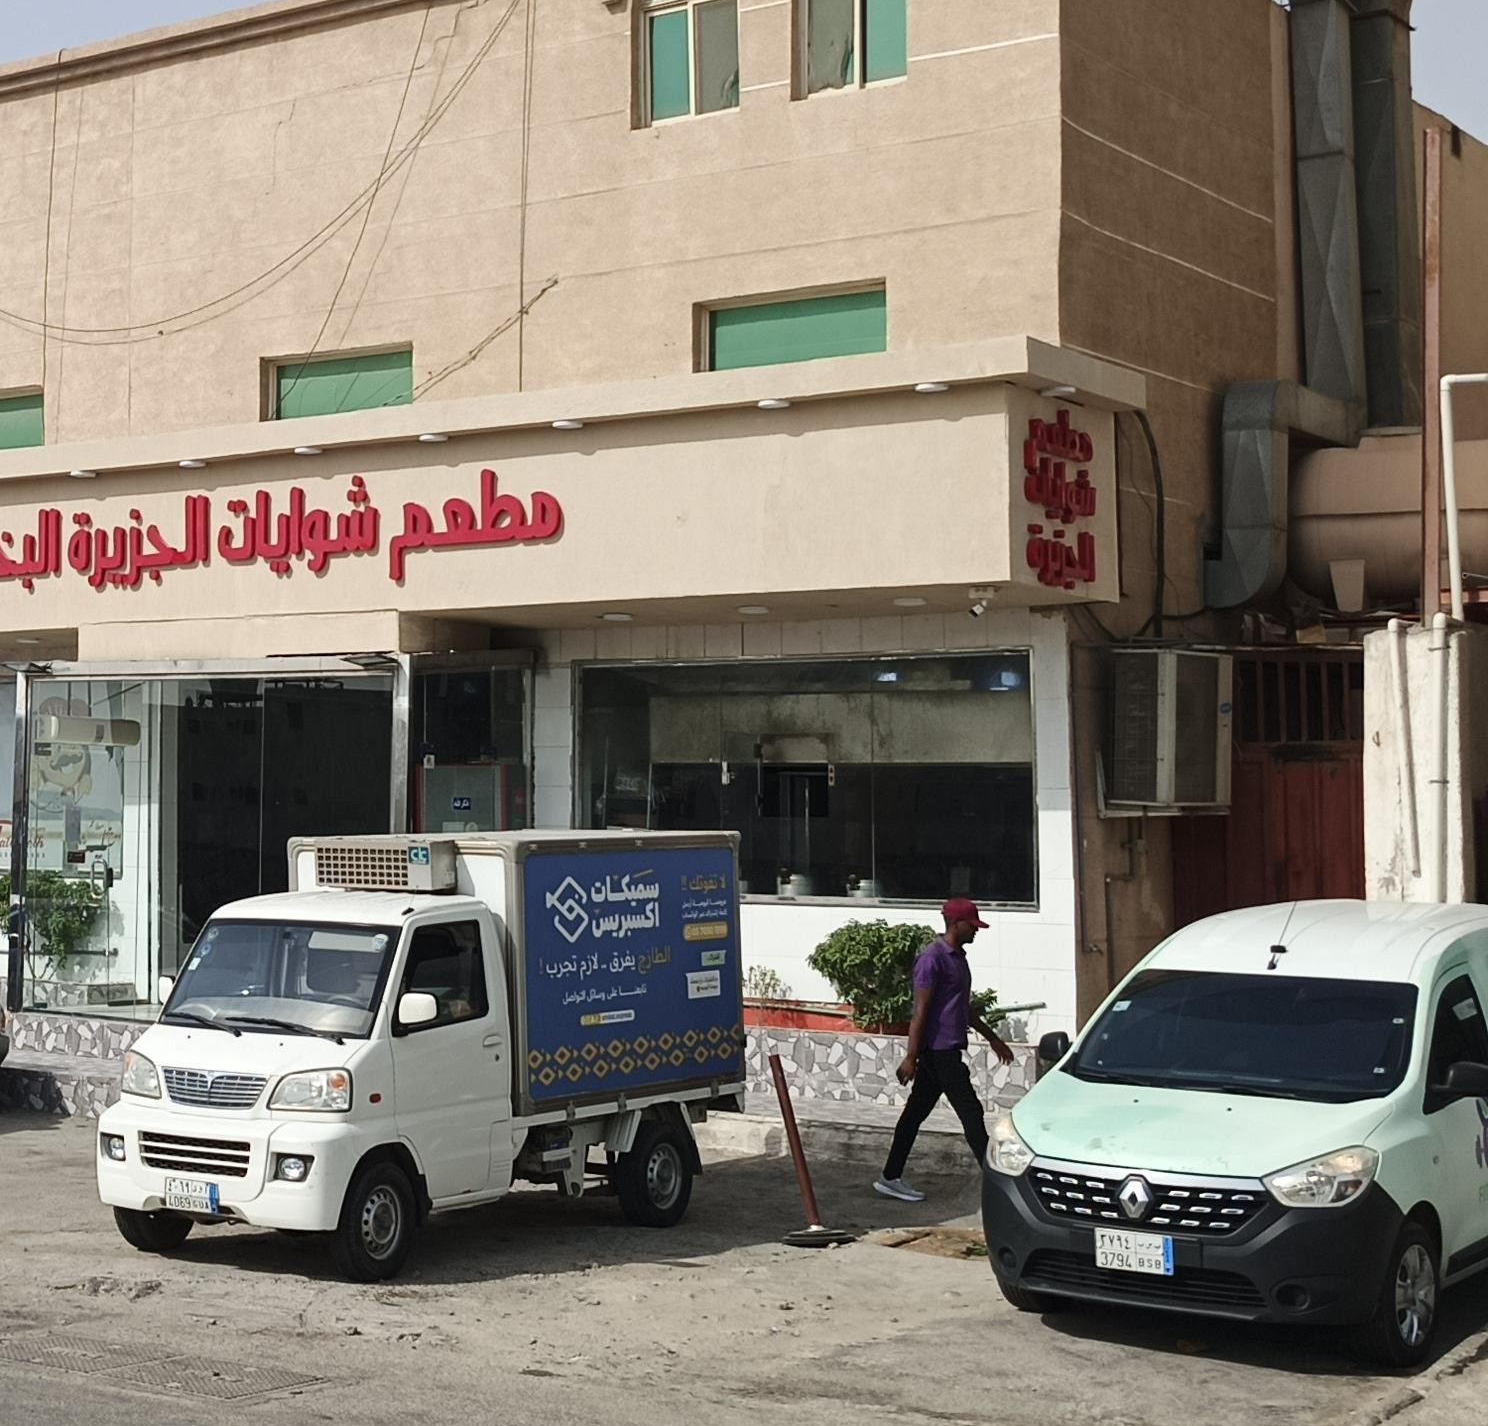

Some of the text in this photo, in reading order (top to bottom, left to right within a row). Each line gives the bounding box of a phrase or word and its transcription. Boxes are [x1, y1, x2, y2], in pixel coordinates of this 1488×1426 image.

[1023, 409, 1094, 473] مطعم
[1024, 457, 1096, 524] شوايات
[67, 495, 211, 588] الجزيرة
[217, 475, 380, 576] شوايات
[389, 469, 564, 585] مطعم
[1026, 524, 1096, 590] الجزيرة
[546, 955, 577, 978] تجرب
[579, 952, 598, 980] لازم
[609, 950, 636, 972] يفرق
[1100, 1252, 1132, 1268] 3794
